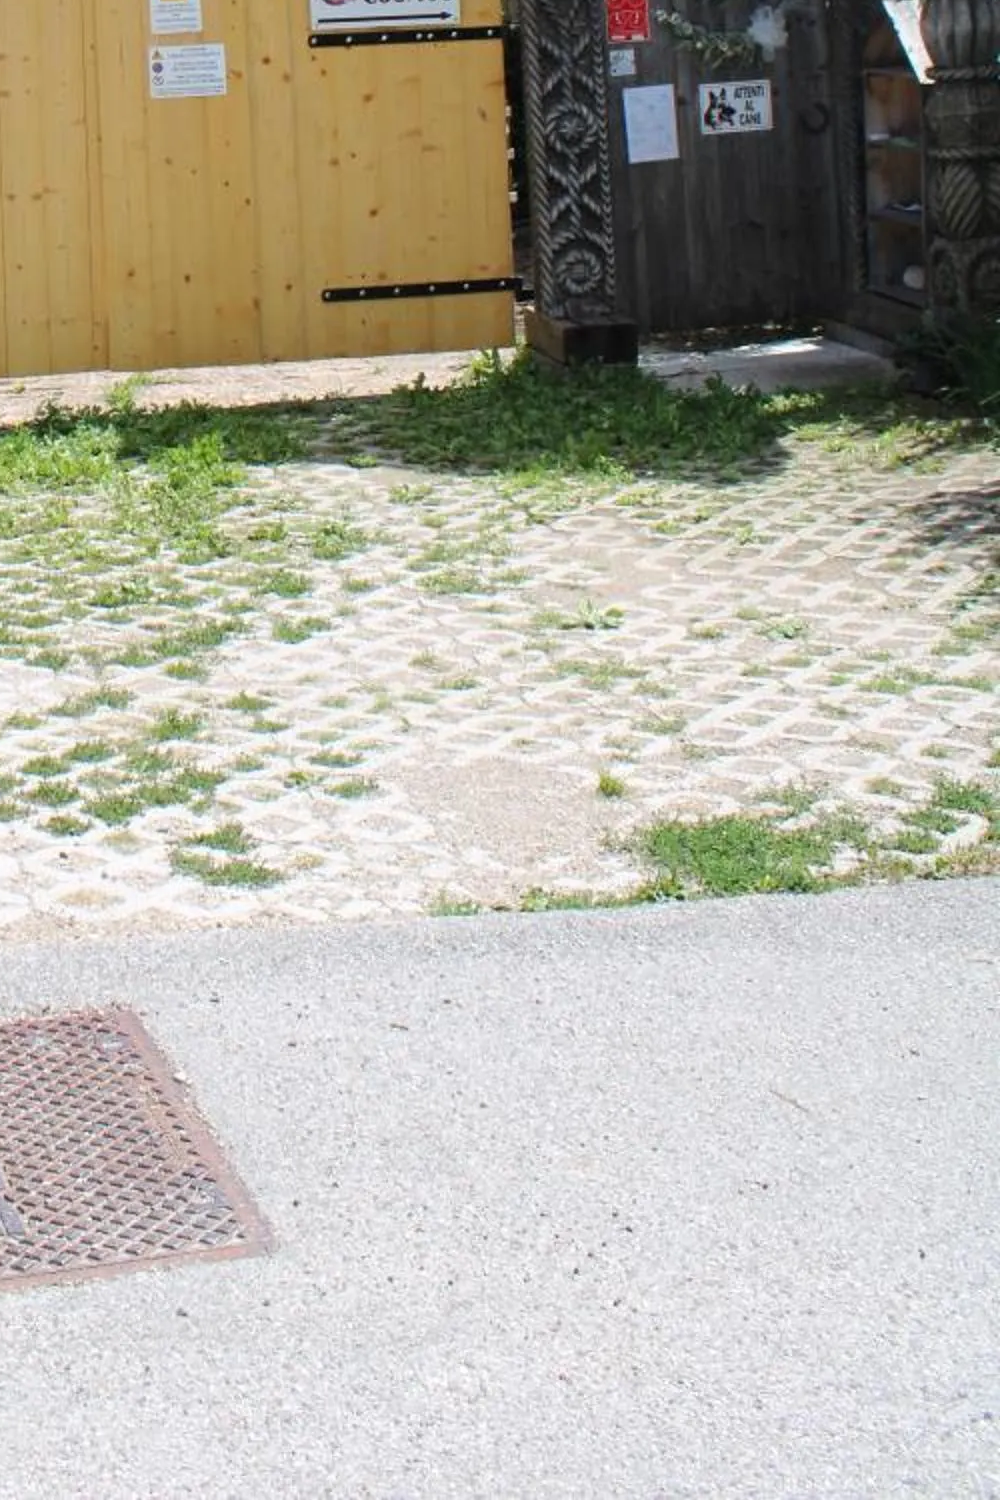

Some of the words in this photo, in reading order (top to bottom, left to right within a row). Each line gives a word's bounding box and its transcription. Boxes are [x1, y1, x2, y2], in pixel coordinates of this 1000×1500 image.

[734, 85, 765, 100] ATTENTI
[745, 100, 756, 111] AL
[739, 112, 762, 126] CANE
